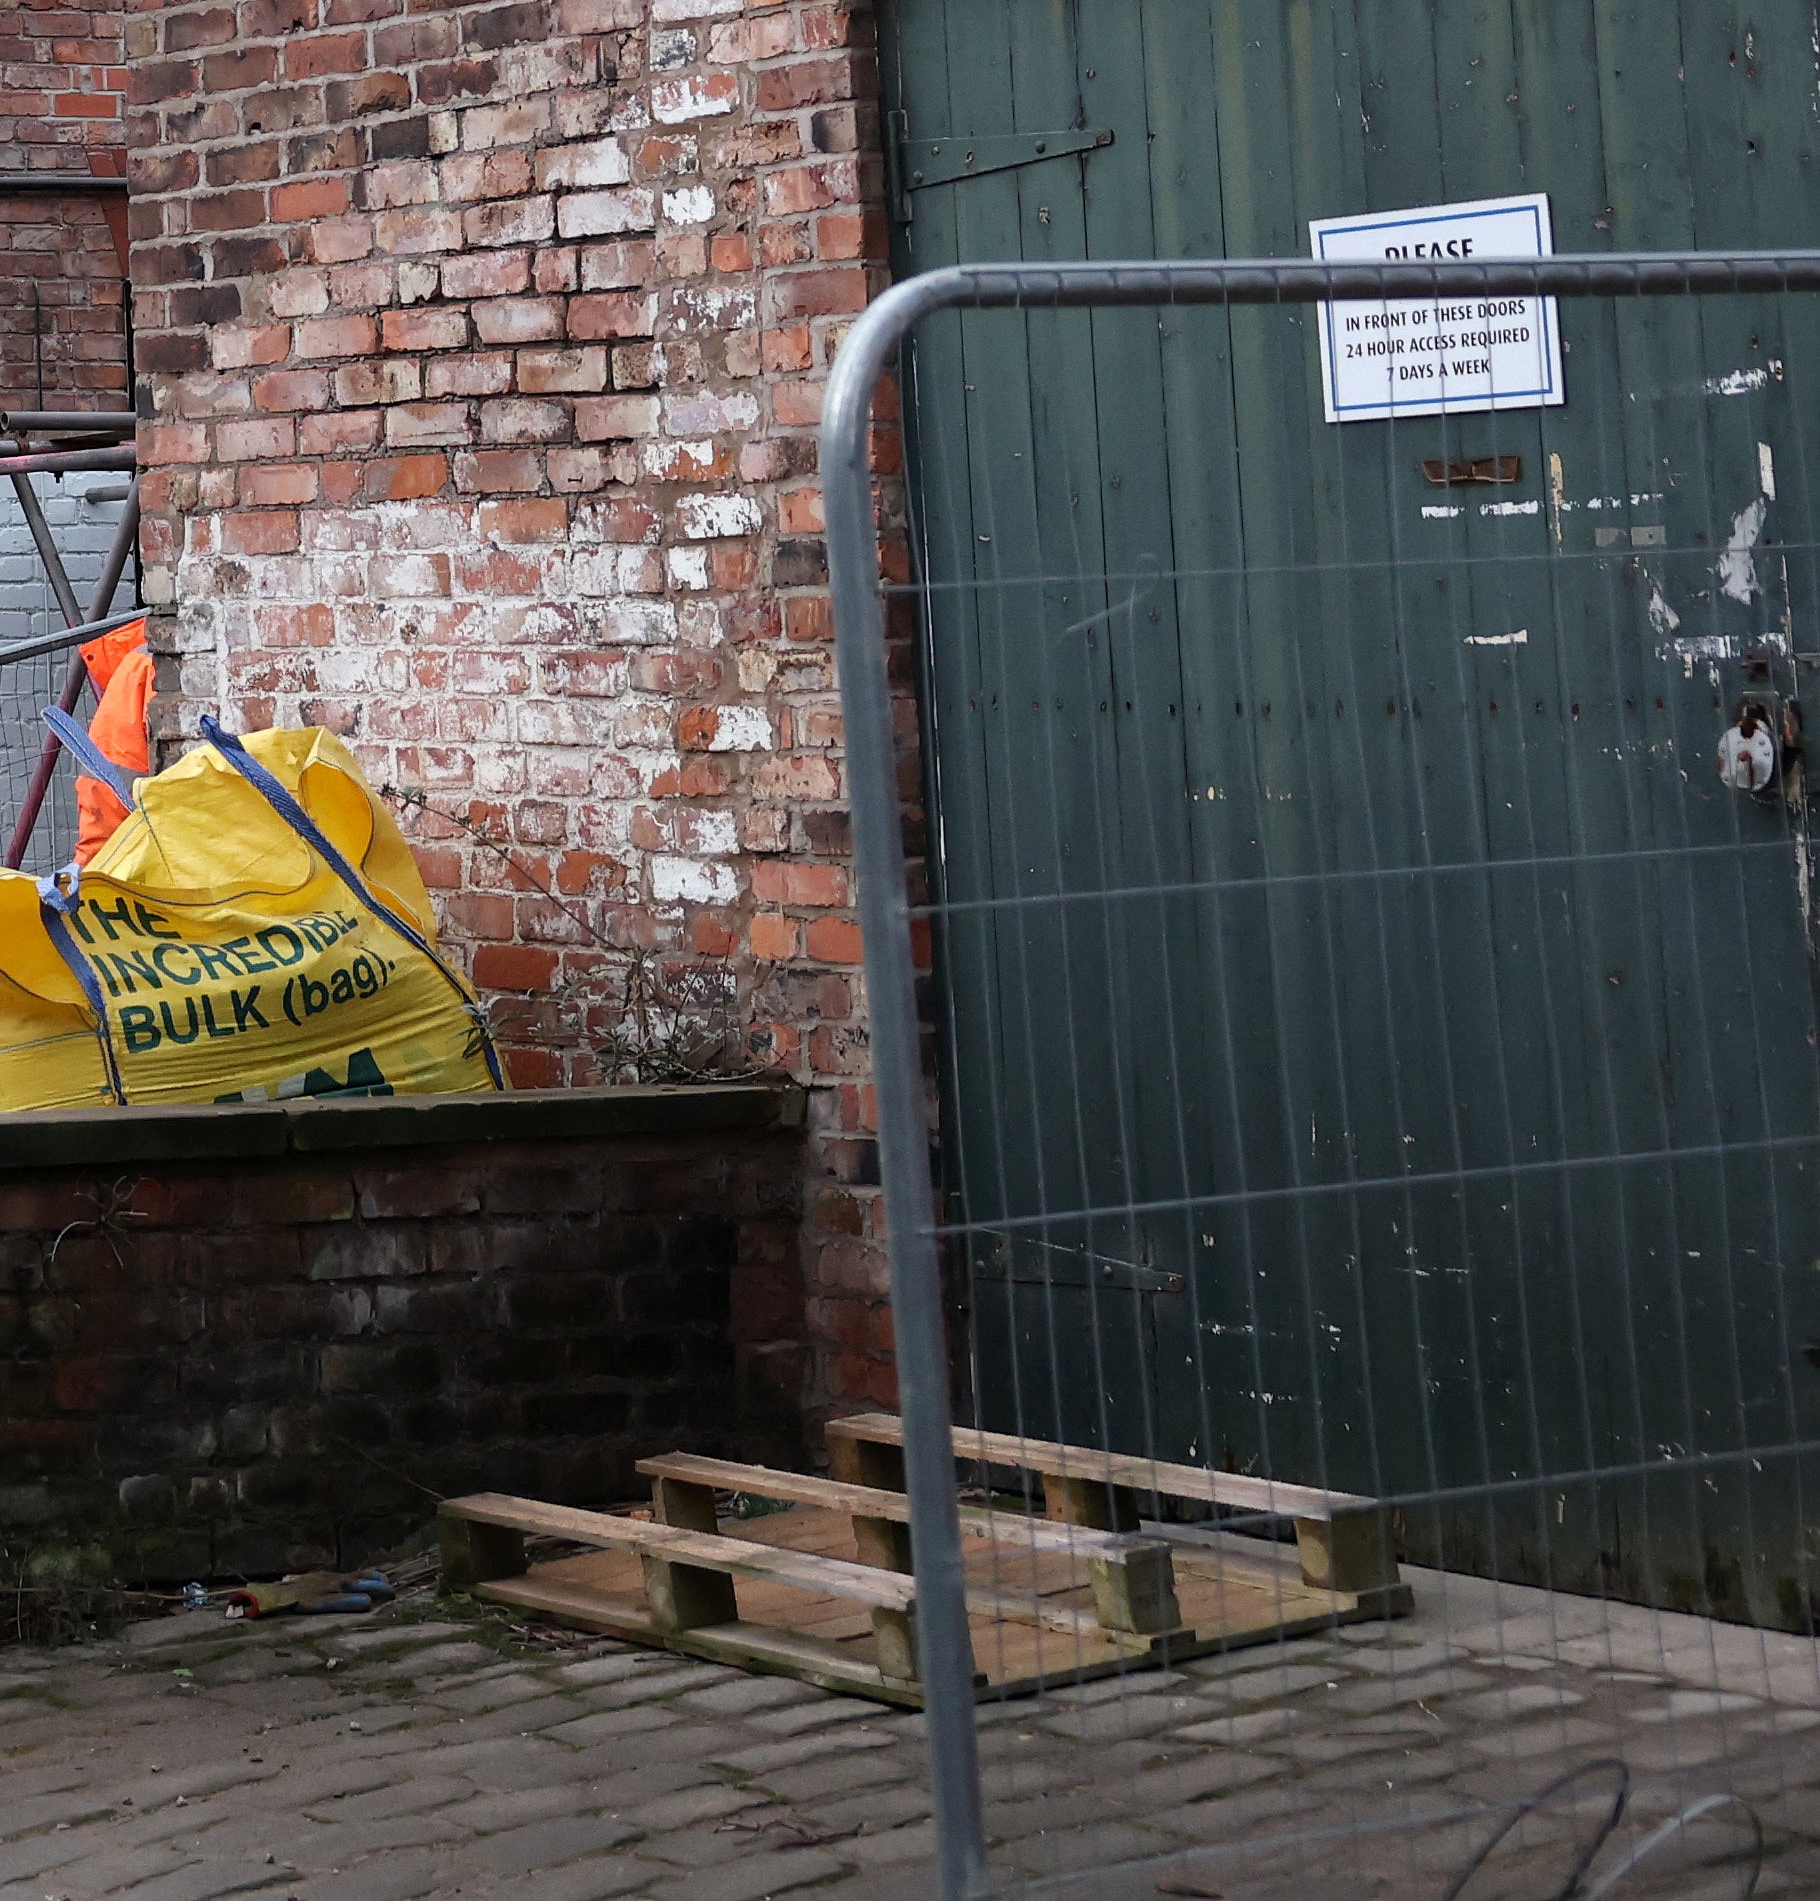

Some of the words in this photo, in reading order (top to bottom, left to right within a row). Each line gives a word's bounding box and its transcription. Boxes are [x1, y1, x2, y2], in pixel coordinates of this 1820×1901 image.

[1346, 316, 1360, 331] IN
[1364, 311, 1407, 330] FRONT
[1412, 309, 1429, 325] OF
[1434, 305, 1473, 323] THESE
[1477, 300, 1526, 319] DOORS
[1346, 343, 1362, 358] 24
[1367, 339, 1405, 356] HOUR
[1409, 334, 1456, 353] ACCESS
[1461, 327, 1530, 348] REQUIRED
[1386, 367, 1395, 381] 7
[1399, 363, 1434, 380] DAYS
[1439, 362, 1448, 377] A
[1452, 358, 1491, 375] WEEK
[68, 897, 182, 944] THE
[117, 986, 270, 1054] BULK
[283, 944, 396, 1026] (bag).
